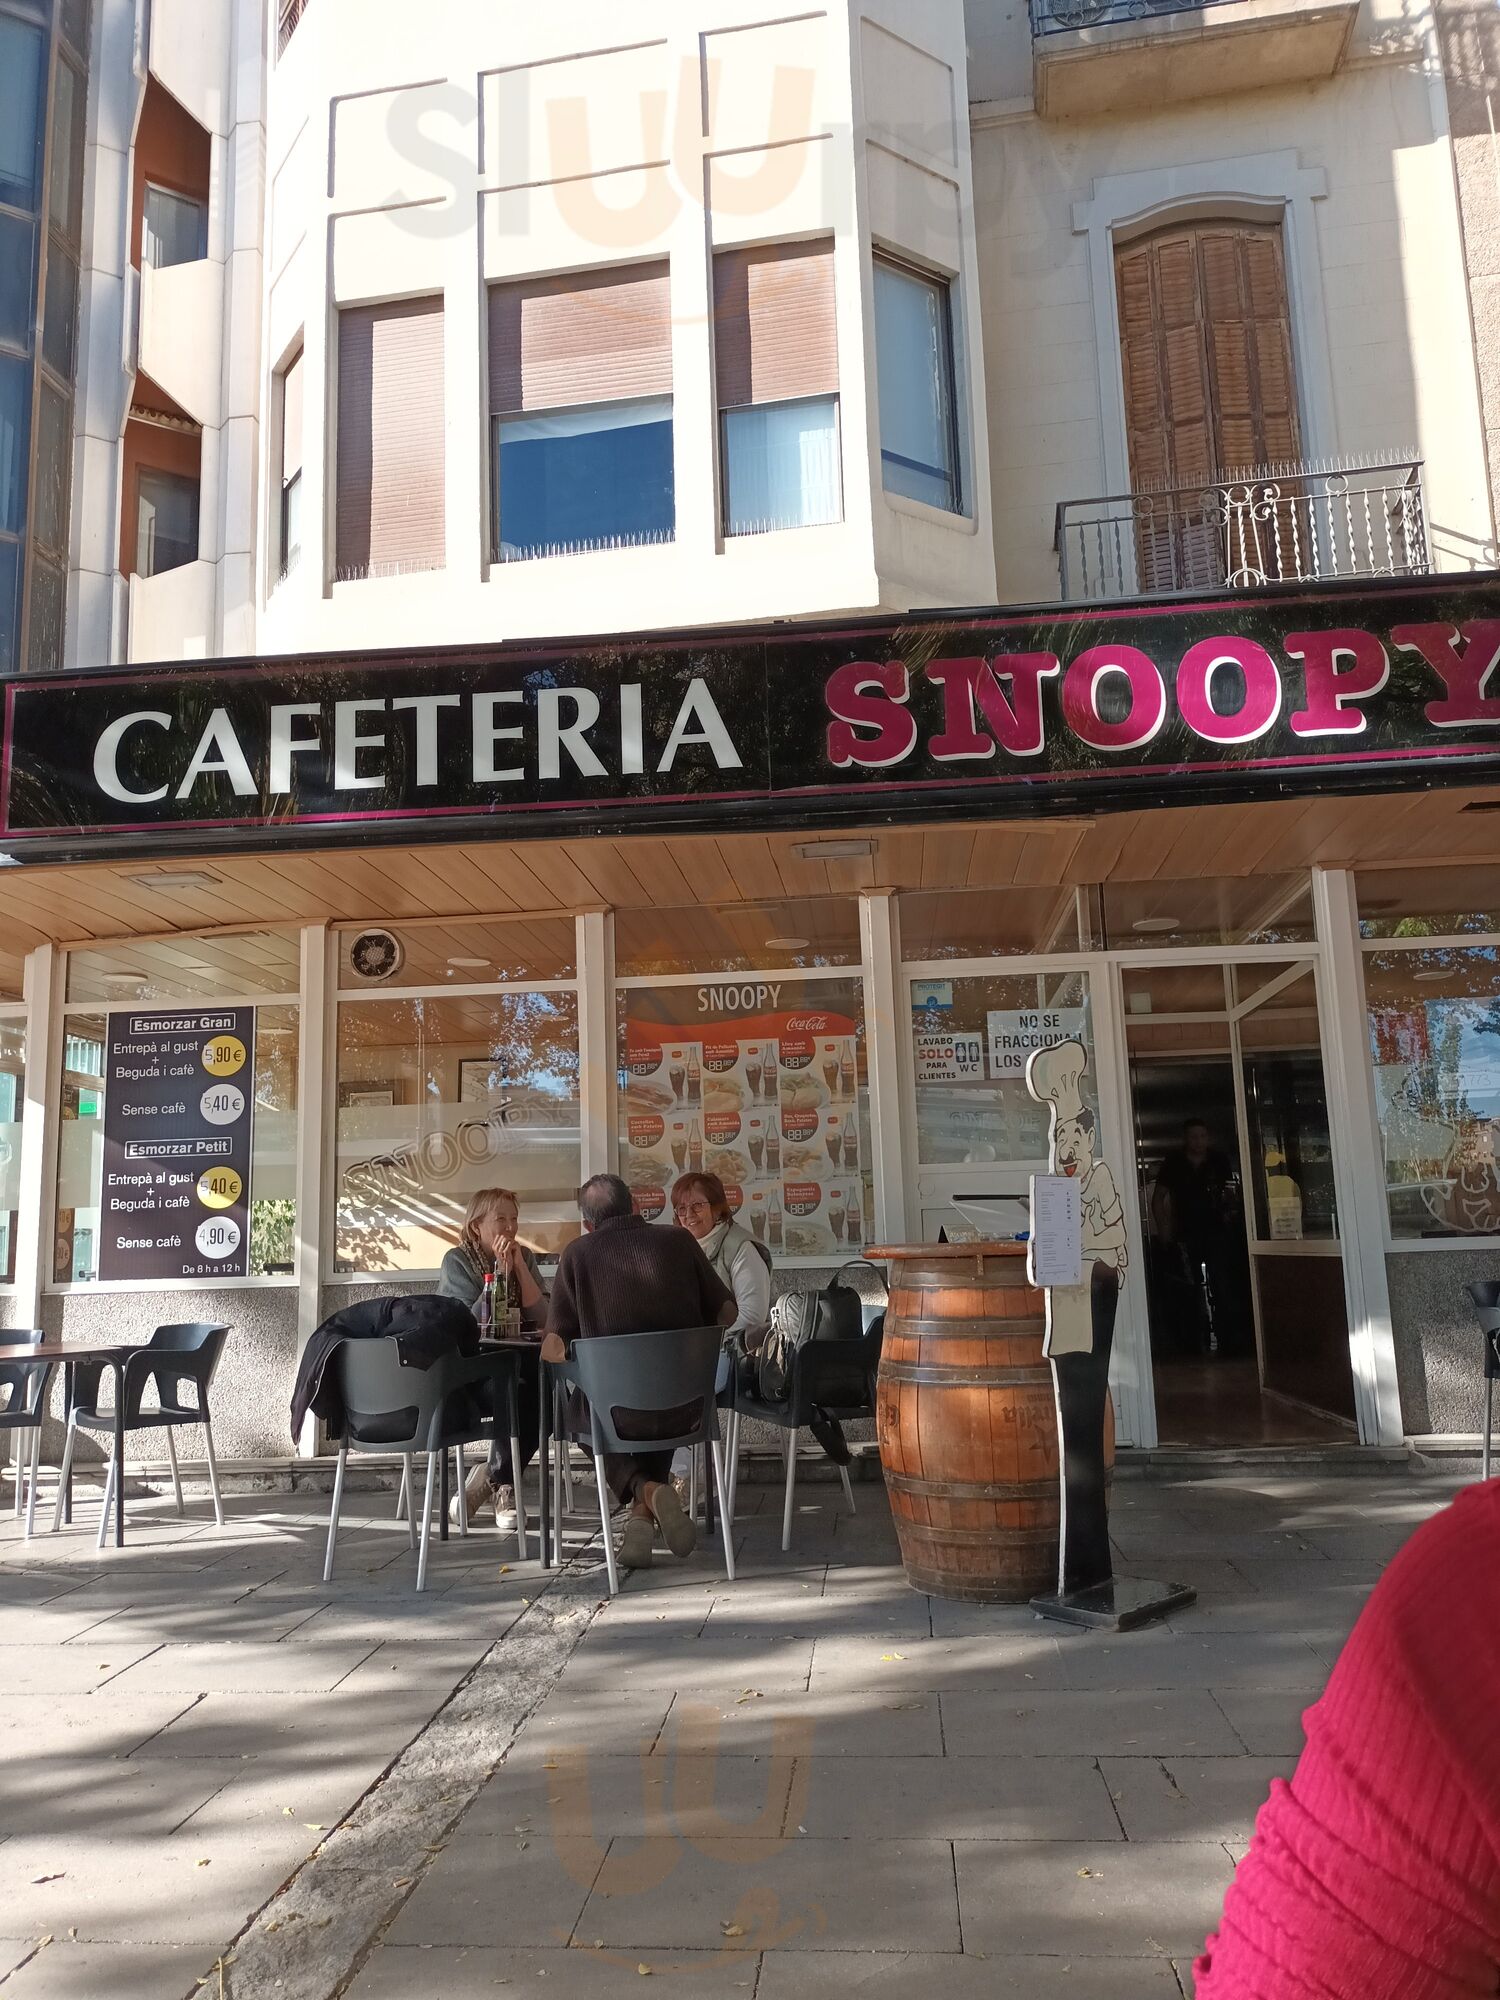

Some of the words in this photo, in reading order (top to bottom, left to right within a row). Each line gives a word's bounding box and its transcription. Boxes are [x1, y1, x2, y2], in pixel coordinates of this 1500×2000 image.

[93, 678, 743, 803] CAFETERIA
[825, 619, 1500, 767] SNOOPY
[697, 985, 782, 1012] SNOOPY
[134, 1020, 197, 1032] Esmorzar
[200, 1017, 231, 1029] Gran
[1019, 1015, 1038, 1028] NO
[1043, 1014, 1060, 1027] SE
[113, 1042, 157, 1056] Entrepà
[160, 1041, 170, 1052] al
[173, 1041, 198, 1055] gust
[917, 1037, 953, 1045] LAVABO
[204, 1046, 231, 1064] 5,90
[233, 1049, 242, 1062] €
[918, 1048, 954, 1059] SOLO
[996, 1055, 1022, 1068] LOS
[116, 1065, 160, 1080] Beguda
[163, 1065, 167, 1076] i
[169, 1064, 195, 1076] cafè
[122, 1104, 158, 1116] Sense
[161, 1102, 186, 1114] cafè
[204, 1095, 229, 1113] 5,40
[232, 1098, 241, 1110] €
[129, 1143, 193, 1156] Esmorzar
[196, 1141, 228, 1153] Petit
[108, 1172, 153, 1187] Entrepà
[155, 1172, 166, 1183] al
[168, 1172, 194, 1186] gust
[229, 1181, 239, 1193] €
[110, 1198, 156, 1212] Beguda
[158, 1197, 162, 1208] i
[165, 1196, 190, 1208] cafè
[116, 1236, 153, 1249] Sense
[156, 1235, 181, 1247] cafè
[228, 1231, 237, 1244] €
[182, 1265, 195, 1273] De
[197, 1265, 203, 1273] 8
[205, 1264, 211, 1273] h
[222, 1264, 232, 1272] 12
[234, 1263, 240, 1271] h
